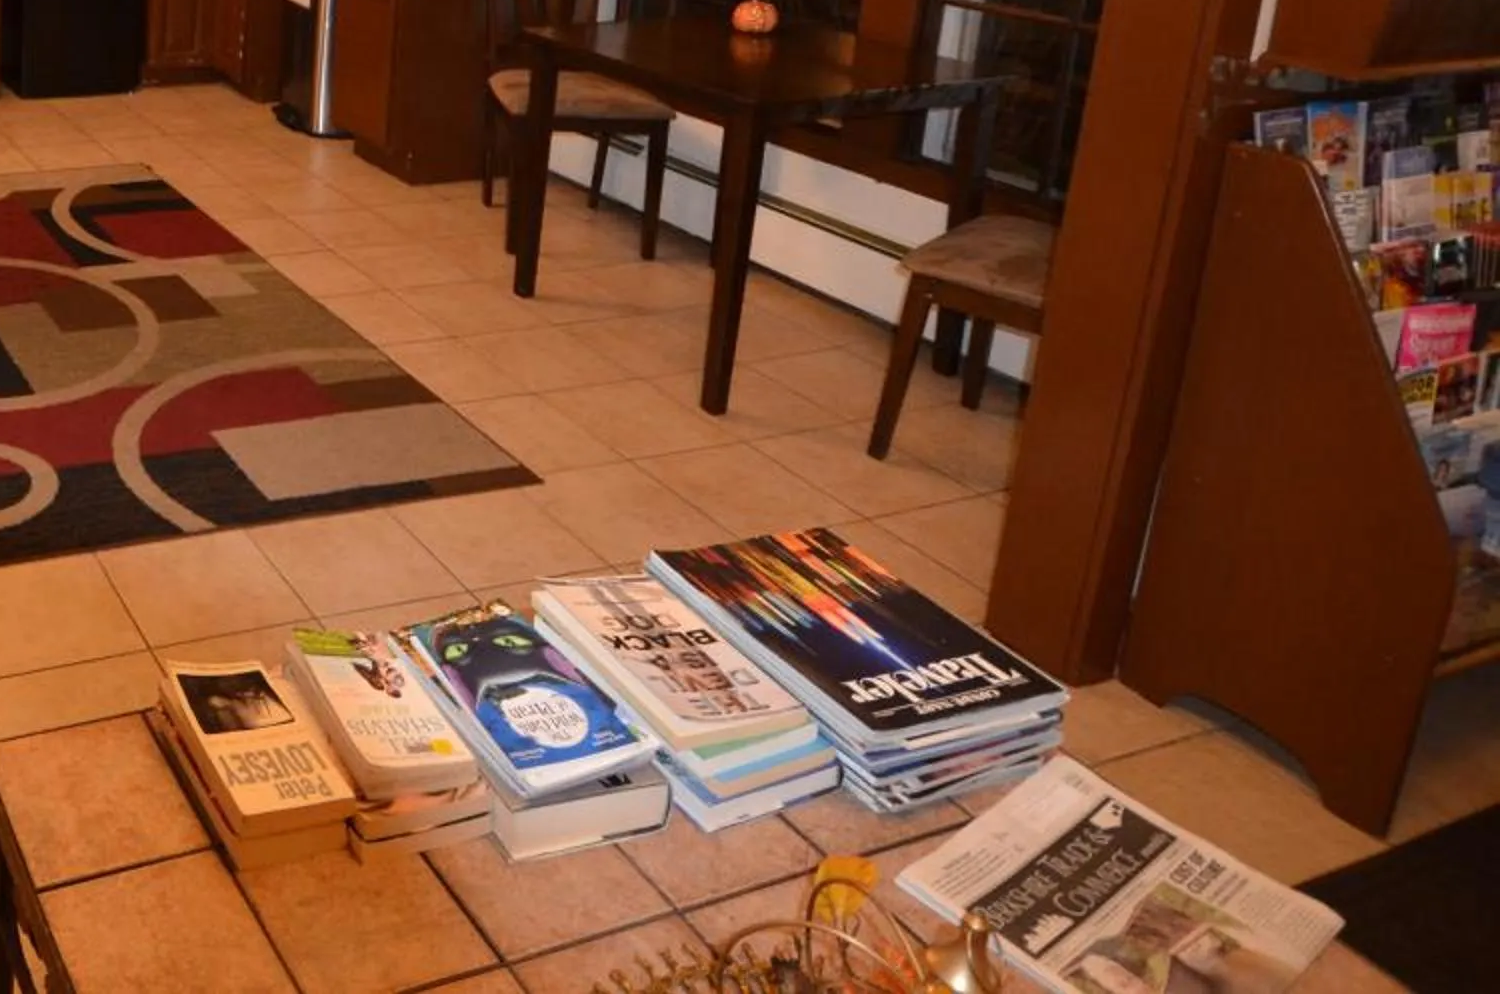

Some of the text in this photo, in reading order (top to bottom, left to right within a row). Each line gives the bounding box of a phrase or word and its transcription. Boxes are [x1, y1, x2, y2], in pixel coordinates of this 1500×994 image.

[601, 613, 681, 632] DOG
[602, 628, 719, 651] BLACK
[680, 650, 718, 669] IS
[647, 668, 761, 693] DEVIL
[840, 651, 1024, 704] Traveler
[689, 691, 771, 716] THE
[217, 740, 329, 787] LOVESEY
[274, 772, 334, 801] Peter
[1053, 847, 1143, 918] COMMERCE
